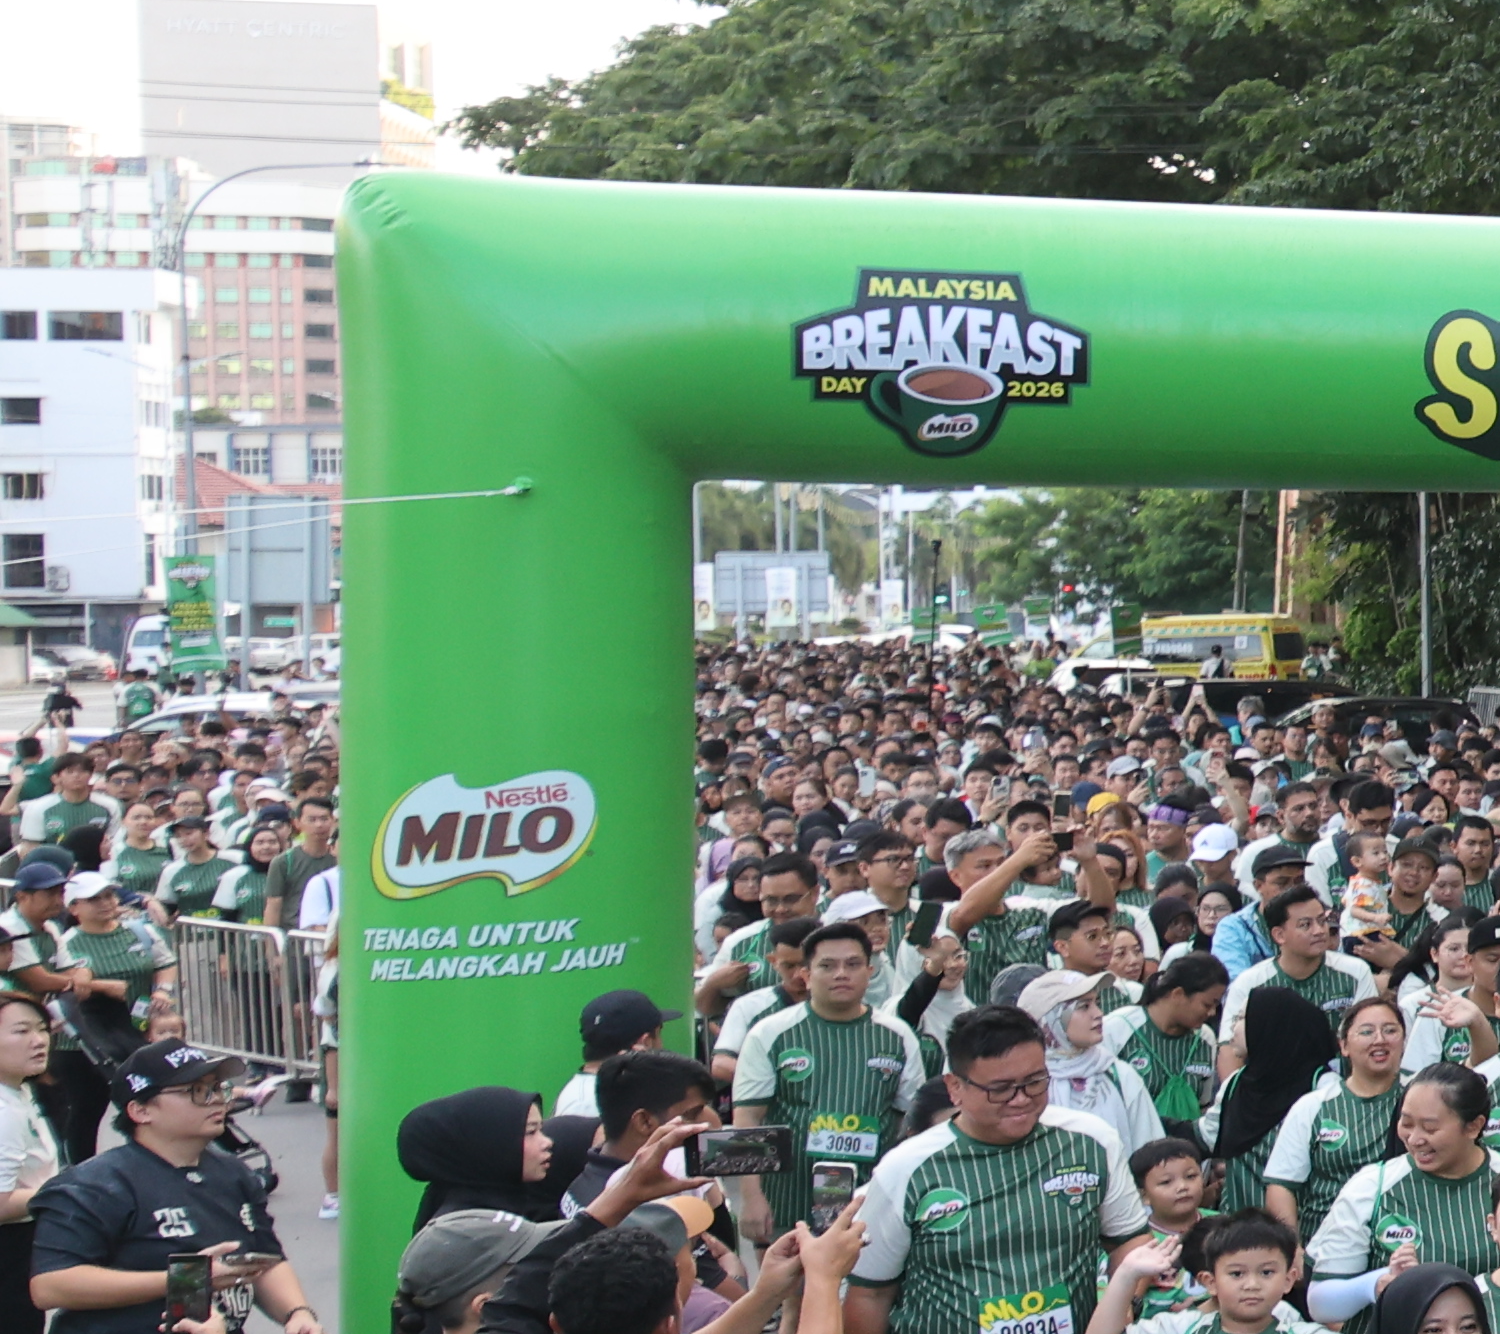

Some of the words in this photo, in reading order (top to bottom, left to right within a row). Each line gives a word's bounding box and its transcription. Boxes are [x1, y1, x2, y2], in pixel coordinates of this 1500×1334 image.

[165, 18, 238, 35] HYATT
[246, 20, 346, 39] CENTRIC
[867, 275, 1018, 302] MALAYSIA
[802, 304, 1082, 376] BREAKFAST
[821, 376, 868, 393] DAY
[1007, 381, 1065, 398] 2026
[927, 421, 973, 435] MILO
[484, 782, 569, 809] Nestlé
[395, 805, 575, 867] MILO
[362, 926, 459, 952] TENAGA
[467, 917, 581, 948] UNTUK
[370, 951, 547, 982] MELANGKAH
[550, 941, 627, 973] JAUH
[826, 1133, 863, 1154] 3090
[1043, 1171, 1100, 1191] BREAKFAST
[1386, 1229, 1414, 1239] MILO
[978, 1291, 1045, 1331] MILO
